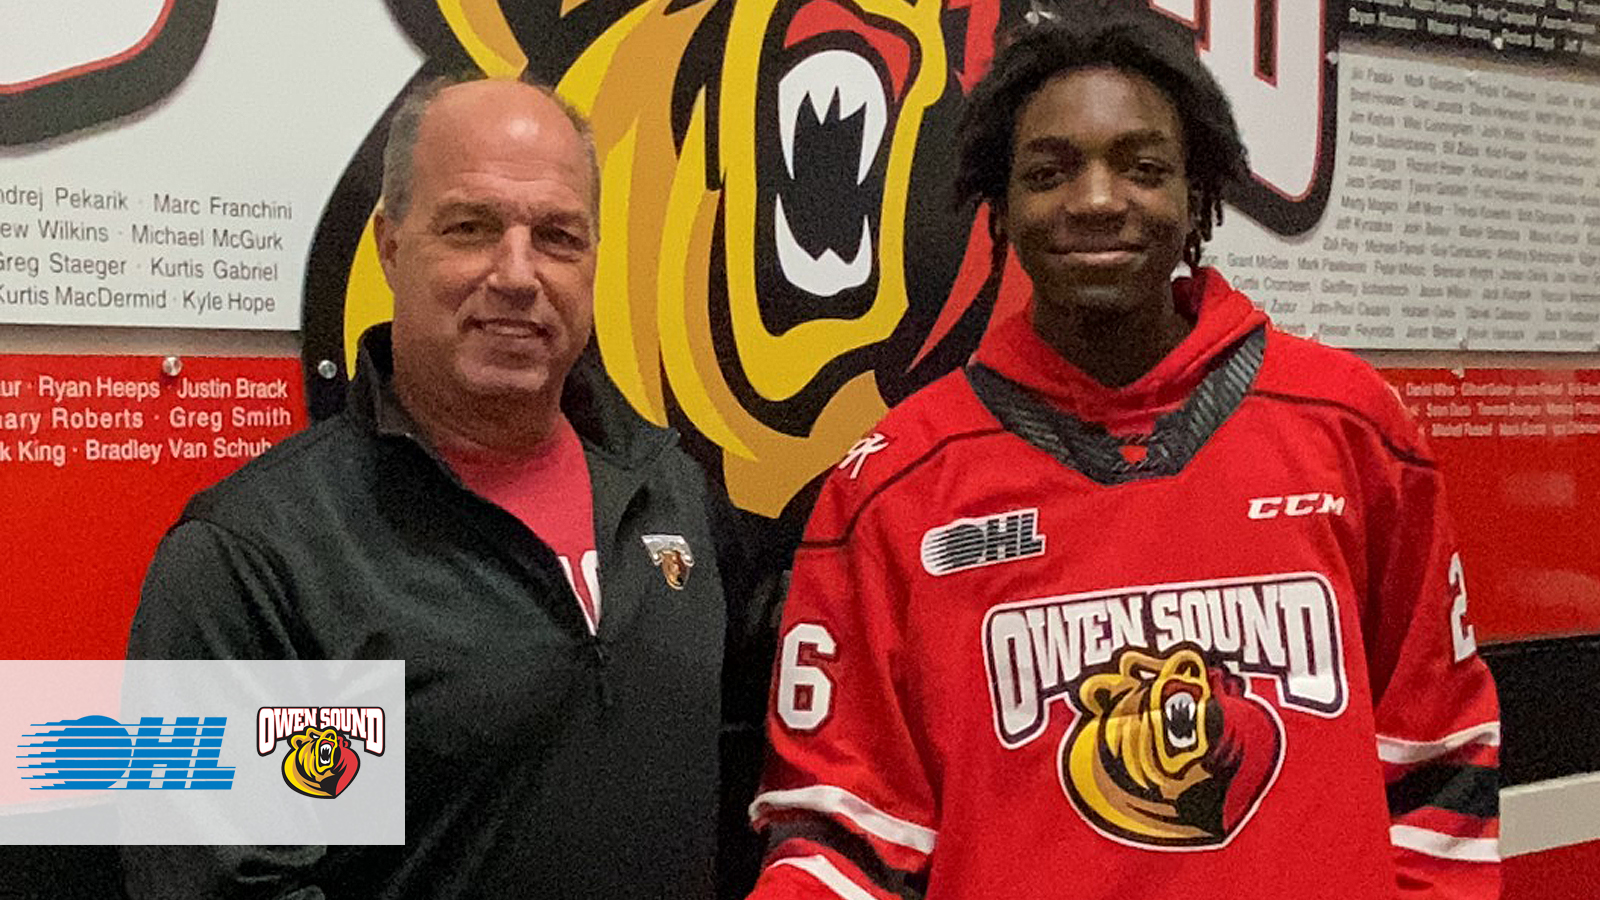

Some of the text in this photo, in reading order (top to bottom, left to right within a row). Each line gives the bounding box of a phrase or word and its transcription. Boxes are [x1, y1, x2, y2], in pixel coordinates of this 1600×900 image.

[55, 187, 128, 210] Pekarik
[154, 193, 200, 215] Marc
[209, 196, 293, 220] Franchini
[38, 219, 109, 242] Wilkins
[131, 224, 205, 247] Michael
[212, 228, 283, 250] McGurk
[50, 253, 127, 279] Staeger
[151, 257, 204, 279] Kurtis
[213, 259, 278, 281] Gabriel
[55, 286, 167, 309] MacDermid
[183, 290, 222, 315] Kyle
[229, 293, 275, 314] Hope
[39, 376, 91, 402] Ryan
[97, 376, 160, 401] Heeps
[177, 378, 231, 398] Justin
[236, 377, 288, 398] Brack
[52, 408, 143, 428] Roberts
[169, 407, 222, 432] Greg
[232, 406, 291, 427] Smith
[18, 440, 66, 466] King
[86, 439, 162, 464] Bradley
[168, 439, 207, 459] Van
[1247, 493, 1346, 519] CCM
[922, 508, 1046, 575] OHL
[990, 580, 1338, 736] OWEN SOUND
[777, 623, 836, 730] 6
